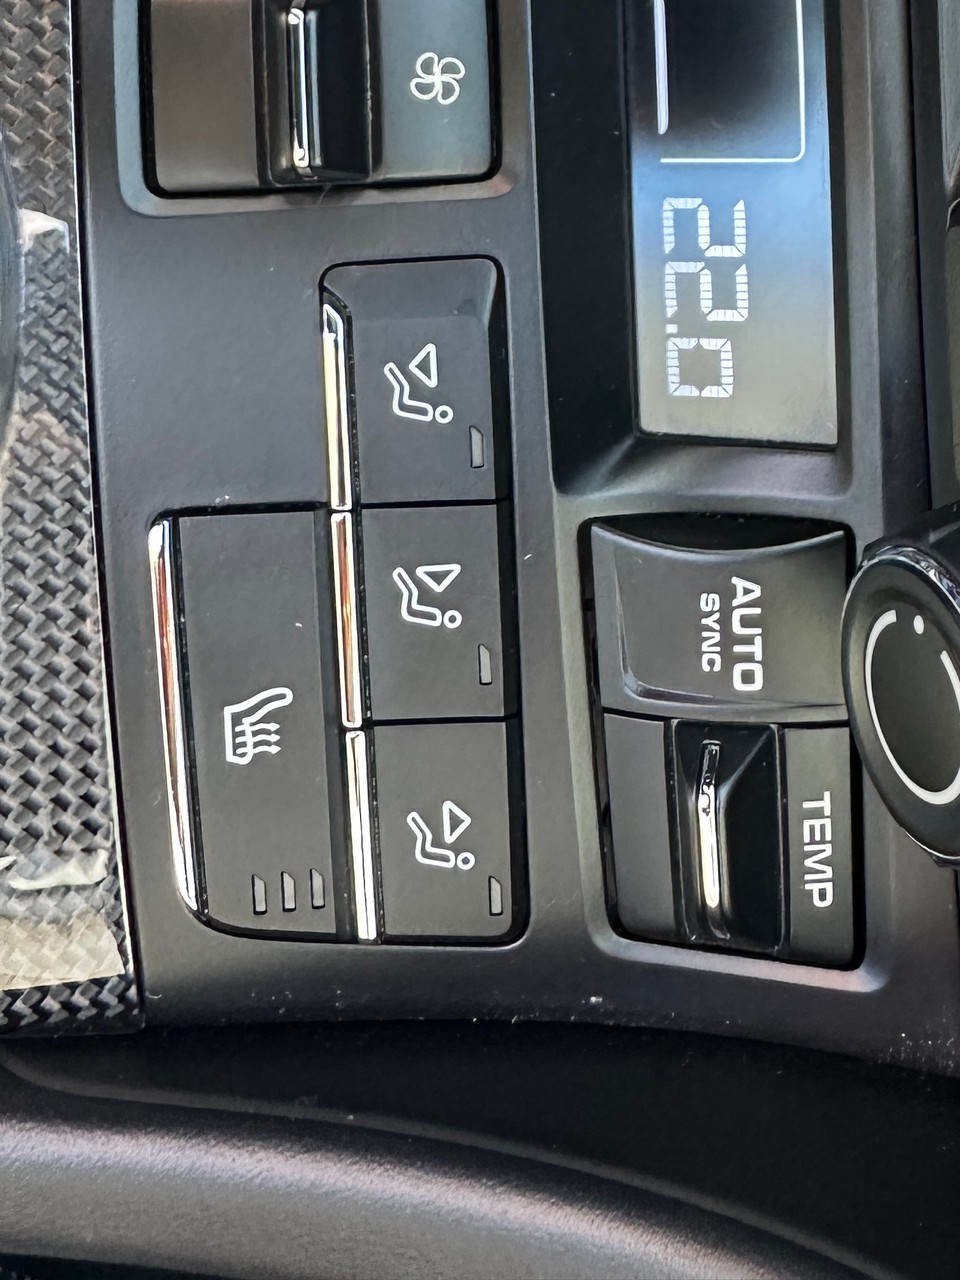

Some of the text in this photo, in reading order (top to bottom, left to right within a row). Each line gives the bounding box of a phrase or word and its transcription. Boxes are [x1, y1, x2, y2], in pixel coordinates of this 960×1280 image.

[662, 198, 749, 399] 22.0
[699, 592, 723, 673] SYNC
[730, 575, 764, 693] AUTO
[801, 790, 835, 909] TEMP
